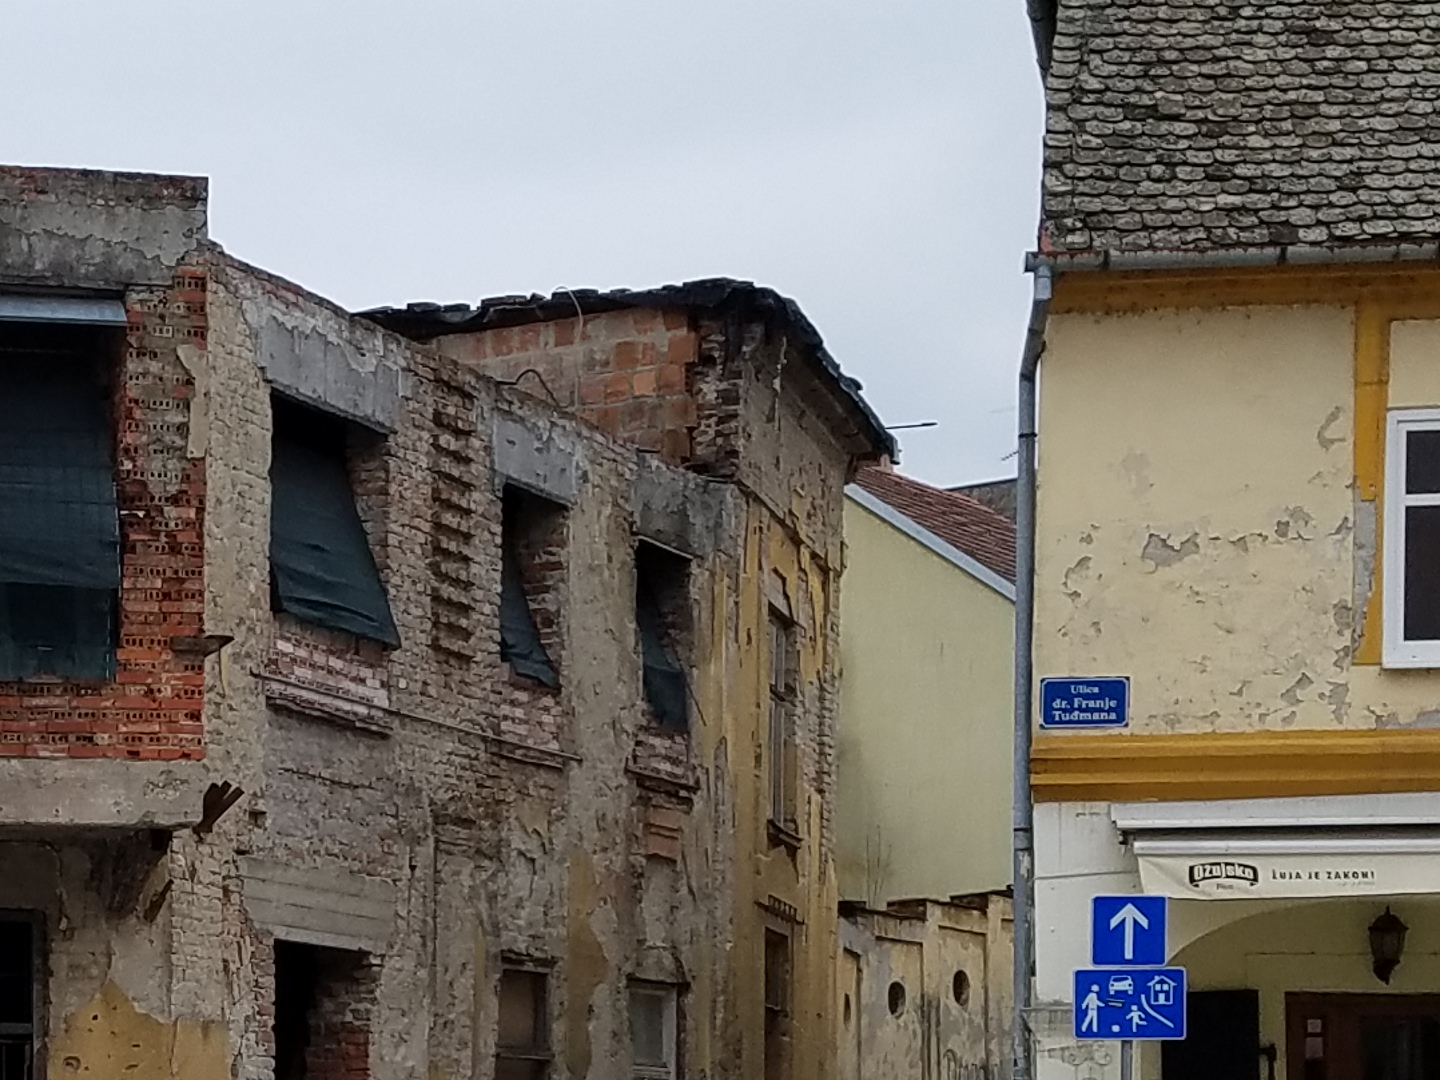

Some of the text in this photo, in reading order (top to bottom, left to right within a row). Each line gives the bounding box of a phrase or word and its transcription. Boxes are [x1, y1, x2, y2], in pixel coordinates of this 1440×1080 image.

[1070, 684, 1100, 694] Ulica
[1052, 697, 1118, 711] dr. Franje
